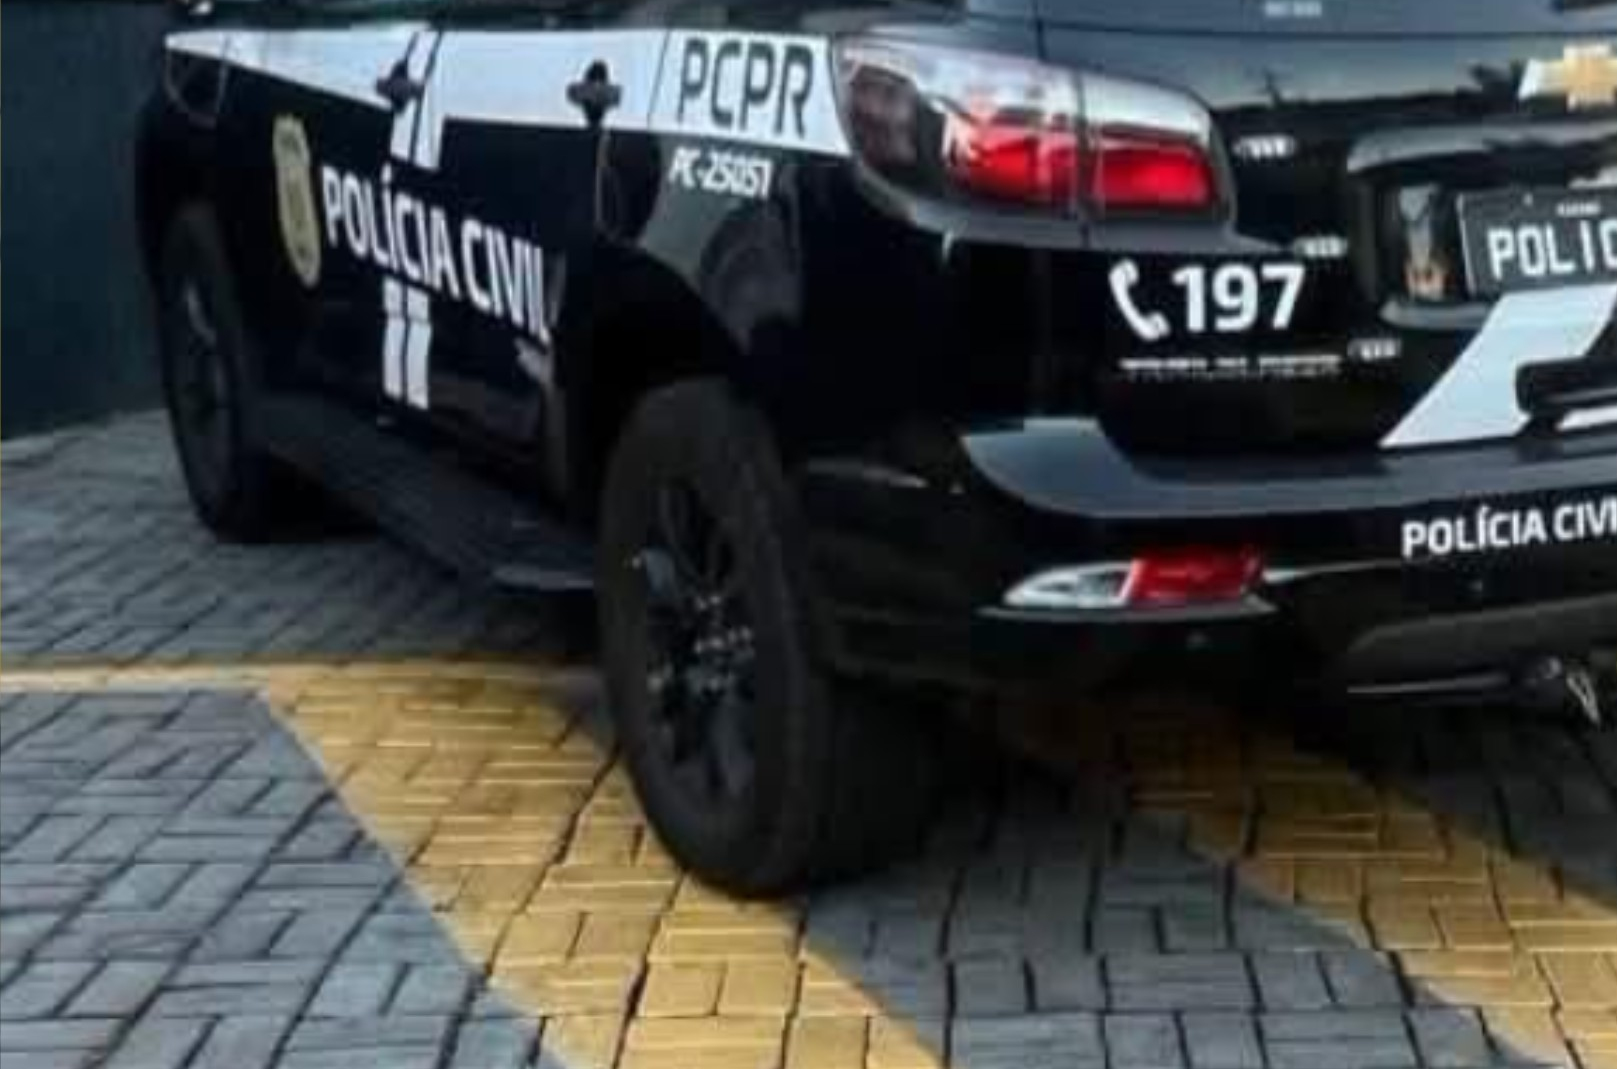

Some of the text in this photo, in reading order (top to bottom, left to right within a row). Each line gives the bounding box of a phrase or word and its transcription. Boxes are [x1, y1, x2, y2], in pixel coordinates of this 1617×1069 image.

[675, 36, 814, 140] PCPR
[322, 160, 551, 347] POLÍCIA CIVIL
[1173, 263, 1305, 332] 197
[1402, 503, 1547, 559] POLÍCIA
